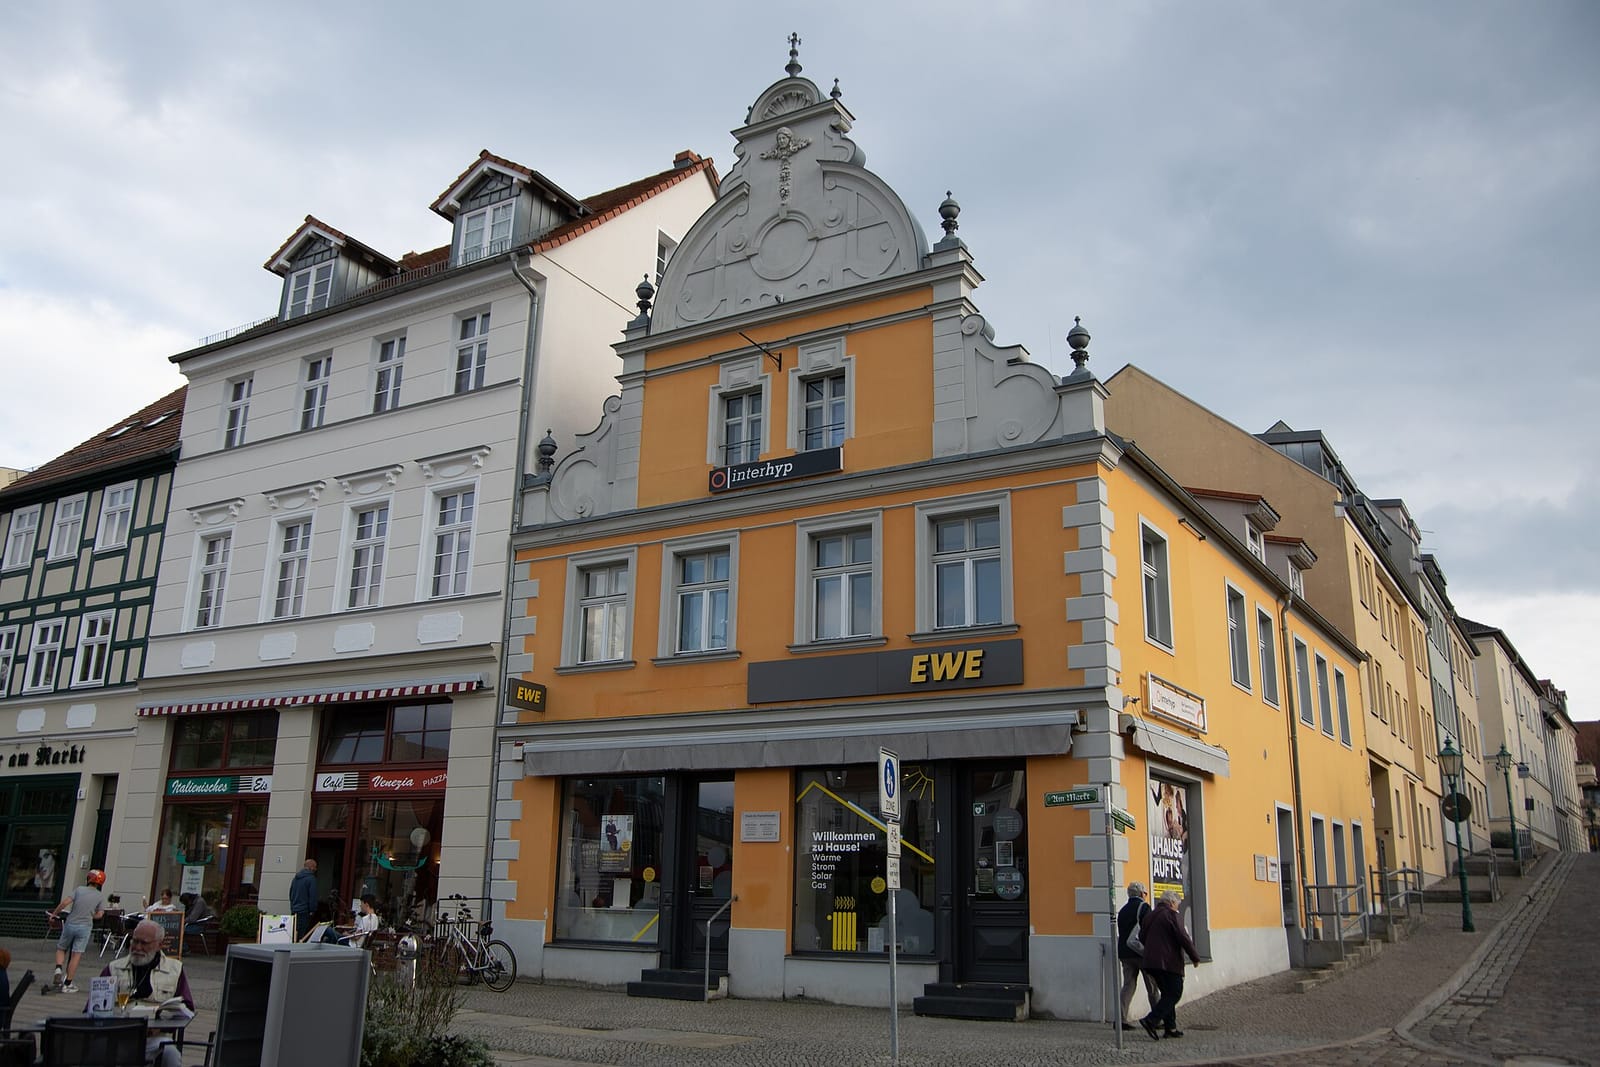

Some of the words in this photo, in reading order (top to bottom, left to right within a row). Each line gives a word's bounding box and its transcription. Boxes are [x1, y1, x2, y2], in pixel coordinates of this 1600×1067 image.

[732, 462, 793, 482] interhyp
[910, 649, 983, 683] EWE
[517, 686, 541, 703] EWE
[8, 753, 29, 768] am
[35, 745, 86, 767] Markt
[171, 778, 228, 794] Italienisches
[253, 777, 268, 792] Eis
[323, 775, 343, 791] Café
[371, 775, 414, 790] Venezia
[1051, 794, 1065, 803] Am
[1066, 792, 1090, 802] Markt
[812, 831, 876, 841] Willkommen
[812, 844, 824, 852] zu
[825, 842, 860, 852] Hause!
[812, 854, 842, 862] Wärme
[811, 862, 836, 871] Strom
[811, 872, 833, 880] Solar
[811, 881, 827, 889] Gas
